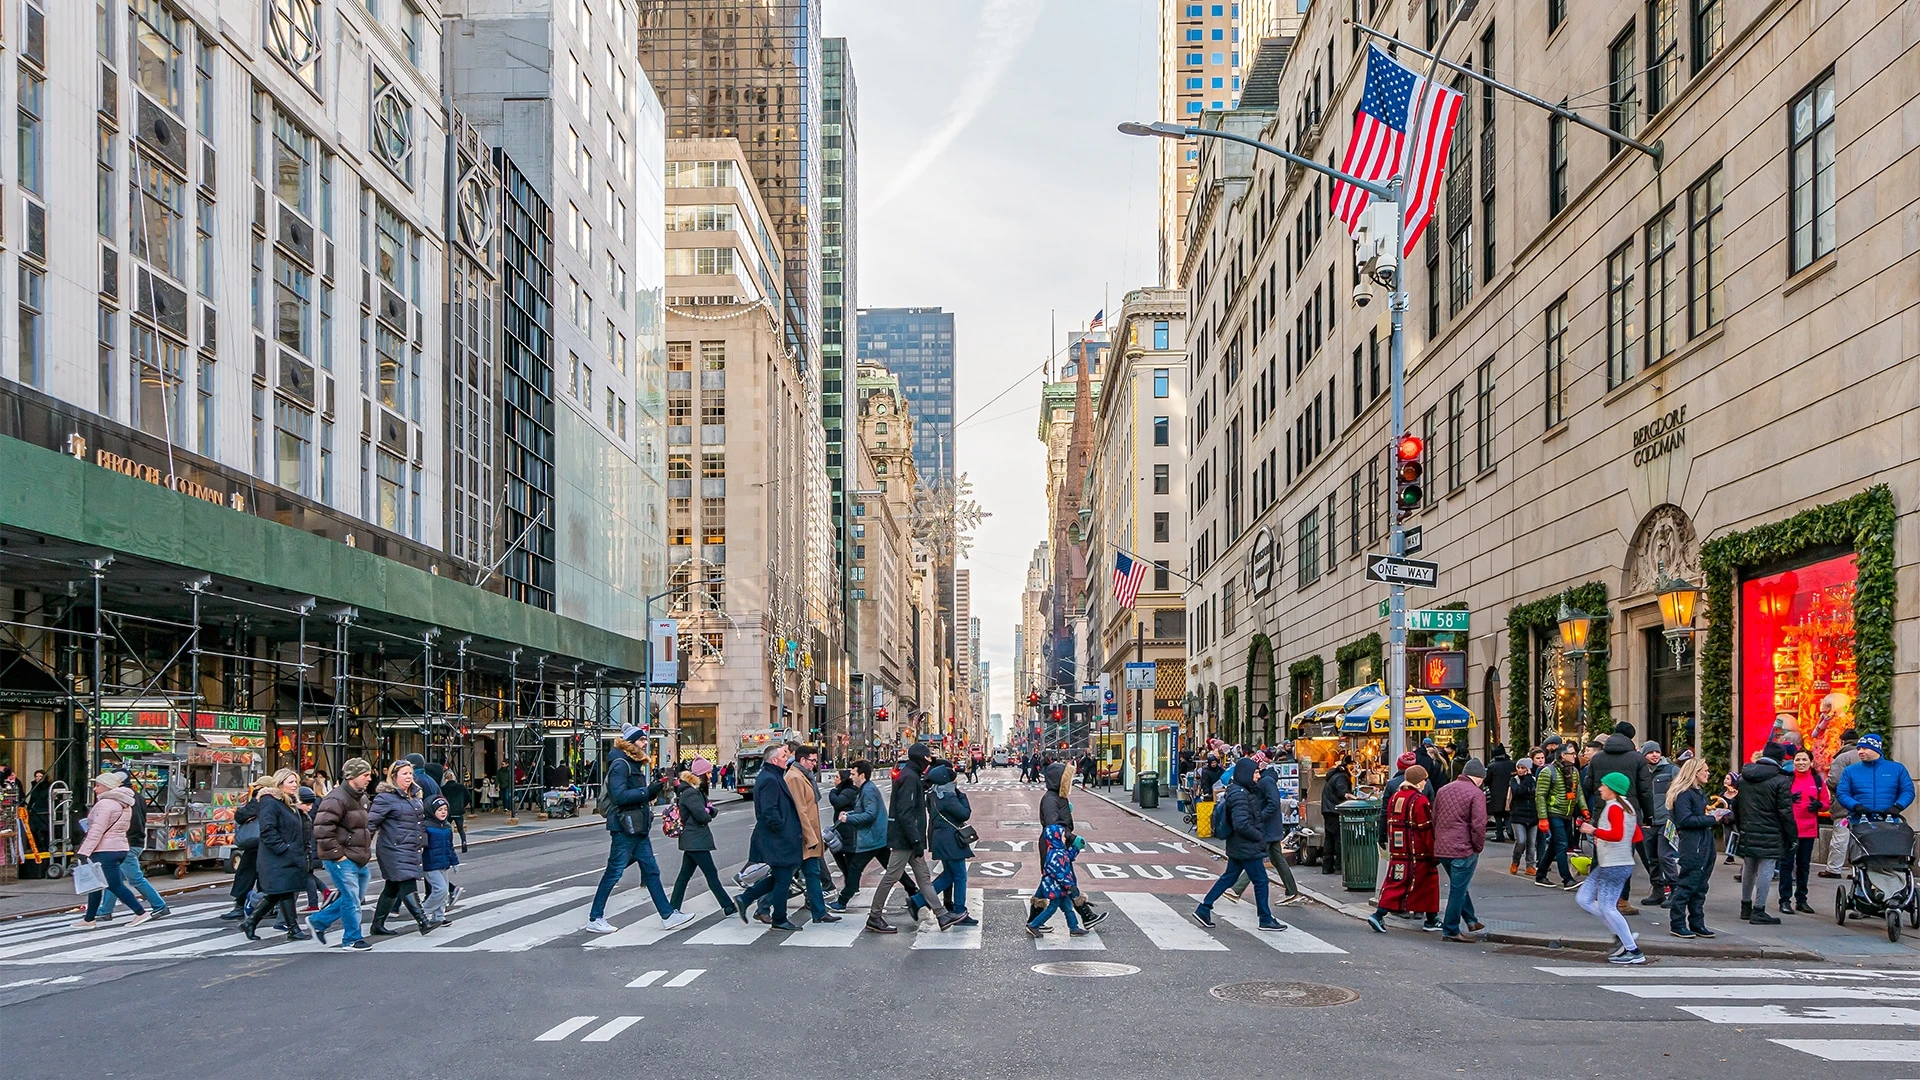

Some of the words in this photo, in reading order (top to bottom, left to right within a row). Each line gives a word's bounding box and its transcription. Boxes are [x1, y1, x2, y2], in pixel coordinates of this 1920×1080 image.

[1633, 404, 1687, 448] BERGDORF
[1633, 427, 1686, 468] GOODMAN
[1406, 534, 1419, 547] WAY
[1377, 563, 1398, 576] ONE
[1407, 567, 1429, 579] WAY
[1421, 612, 1431, 627] W
[1437, 612, 1453, 628] 58
[1456, 613, 1466, 621] ST
[218, 715, 239, 730] FISH
[243, 717, 261, 731] OVER
[1374, 718, 1430, 729] SAETT
[1080, 842, 1191, 854] NLY
[1086, 862, 1221, 880] BUS
